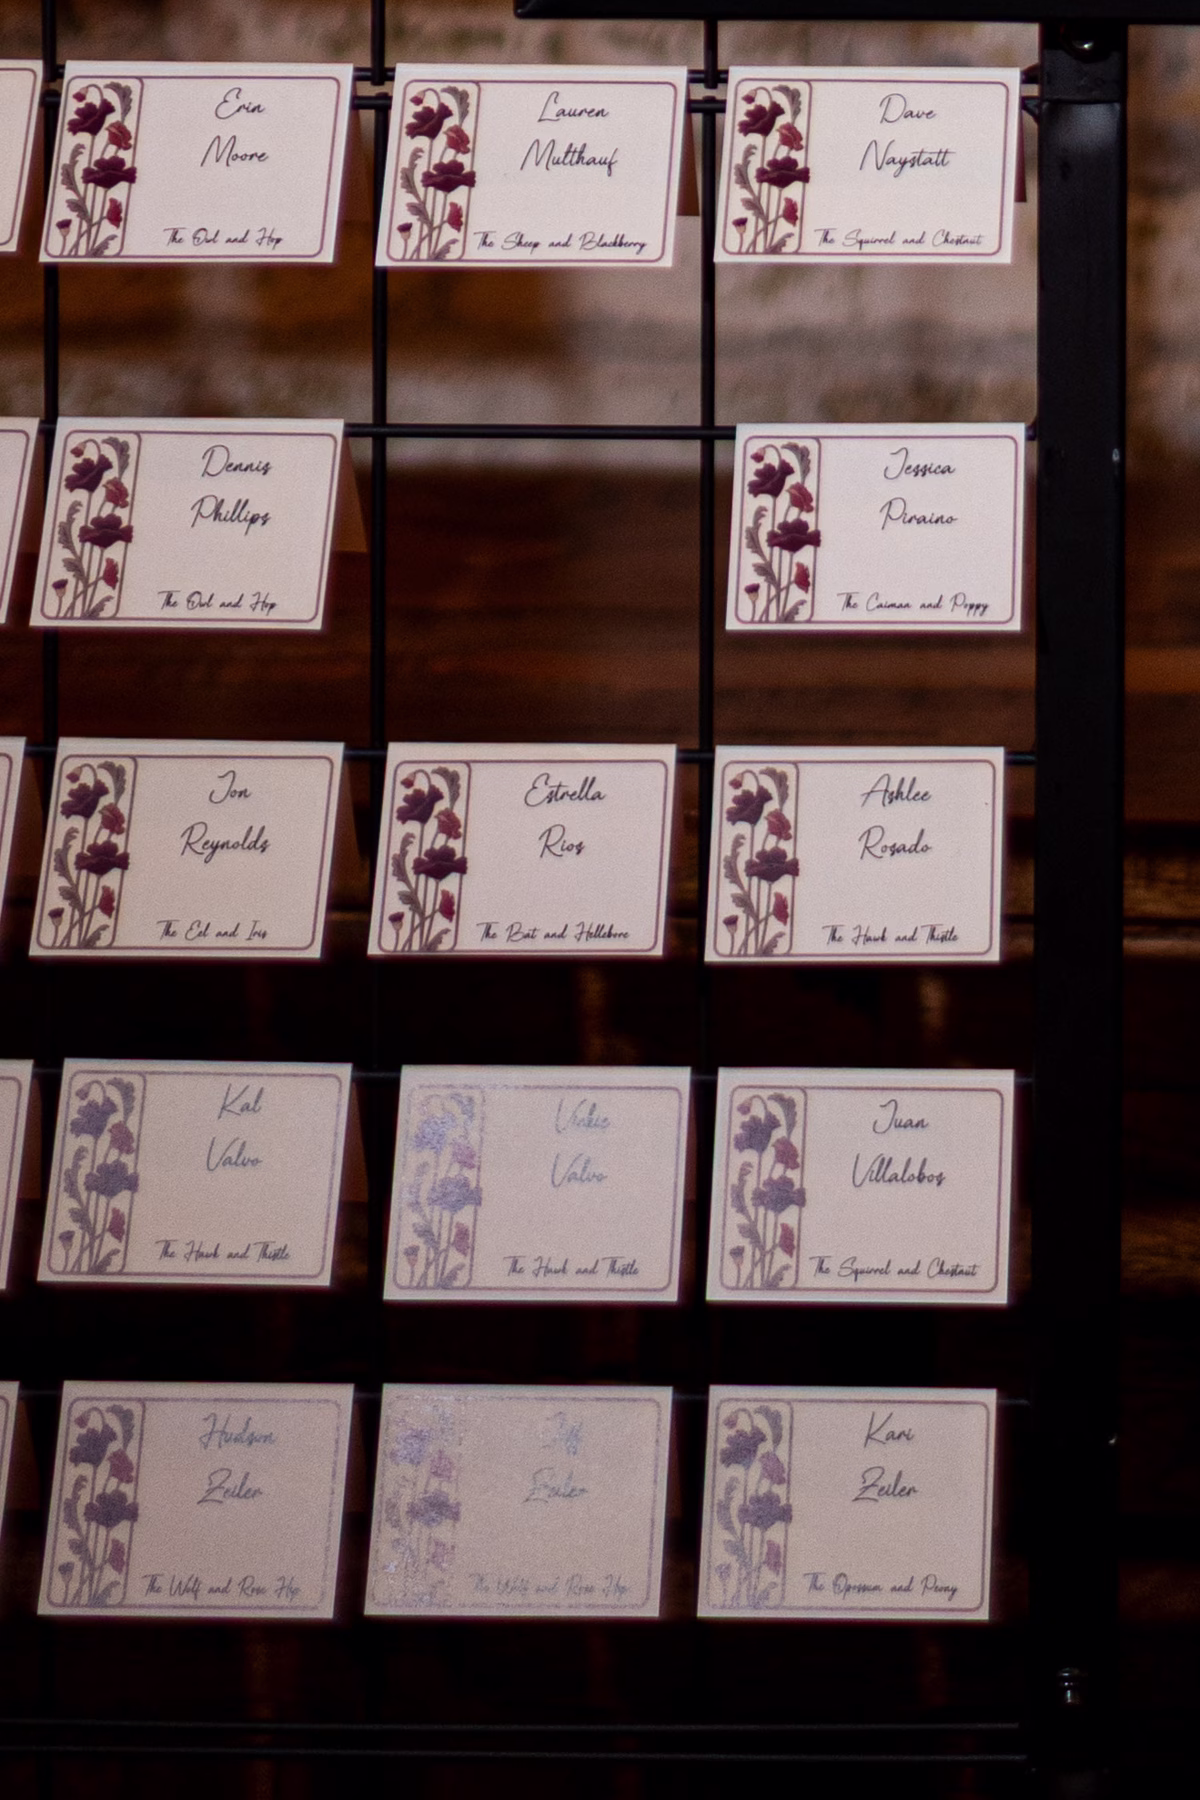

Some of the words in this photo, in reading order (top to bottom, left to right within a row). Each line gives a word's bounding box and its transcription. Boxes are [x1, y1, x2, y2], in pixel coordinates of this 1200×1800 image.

[214, 86, 266, 121] Erin
[537, 90, 610, 124] Lauren
[878, 92, 937, 124] Dave
[199, 134, 269, 168] Moore
[858, 138, 953, 179] Naystatt
[163, 227, 184, 245] The
[191, 227, 221, 247] Owl
[224, 229, 251, 244] and
[255, 227, 284, 249] Hop
[473, 231, 495, 249] The
[503, 231, 541, 254] Sheep
[548, 233, 574, 248] and
[579, 231, 647, 256] Blackberry
[814, 228, 836, 246] The
[843, 228, 897, 251] Squirrel
[901, 230, 927, 245] and
[932, 229, 982, 247] Chestnut
[200, 444, 272, 478] Dennis
[883, 446, 956, 481] Jessica
[190, 494, 271, 537] Phillips
[879, 496, 958, 531] Piraino
[157, 590, 179, 610] The
[185, 590, 215, 611] Owl
[218, 593, 245, 609] and
[249, 591, 278, 616] Hop
[837, 592, 859, 611] The
[866, 592, 912, 612] Caiman
[919, 594, 944, 610] and
[950, 592, 990, 618] Poppy
[208, 769, 252, 806] Jon
[523, 772, 606, 809] Estrella
[861, 773, 932, 808] Ashlee
[180, 821, 270, 865] Reynolds
[538, 823, 586, 859] Rios
[858, 824, 932, 861] Rosado
[156, 919, 178, 940] The
[184, 919, 211, 942] Eel
[214, 922, 241, 938] and
[245, 920, 268, 942] Iris
[477, 921, 498, 942] The
[505, 921, 538, 943] Bat
[543, 923, 569, 940] and
[574, 920, 629, 942] Hellebore
[822, 924, 844, 945] The
[851, 924, 888, 946] Hawk
[894, 926, 919, 943] and
[921, 924, 959, 944] Thistle
[872, 1098, 930, 1136] Juan
[851, 1153, 946, 1189] Villalobos
[808, 1255, 831, 1276] The
[837, 1256, 892, 1283] Squirrel
[896, 1259, 922, 1276] and
[926, 1257, 979, 1280] Chestnut
[863, 1411, 915, 1449] Kari
[851, 1465, 919, 1503] Zeiler
